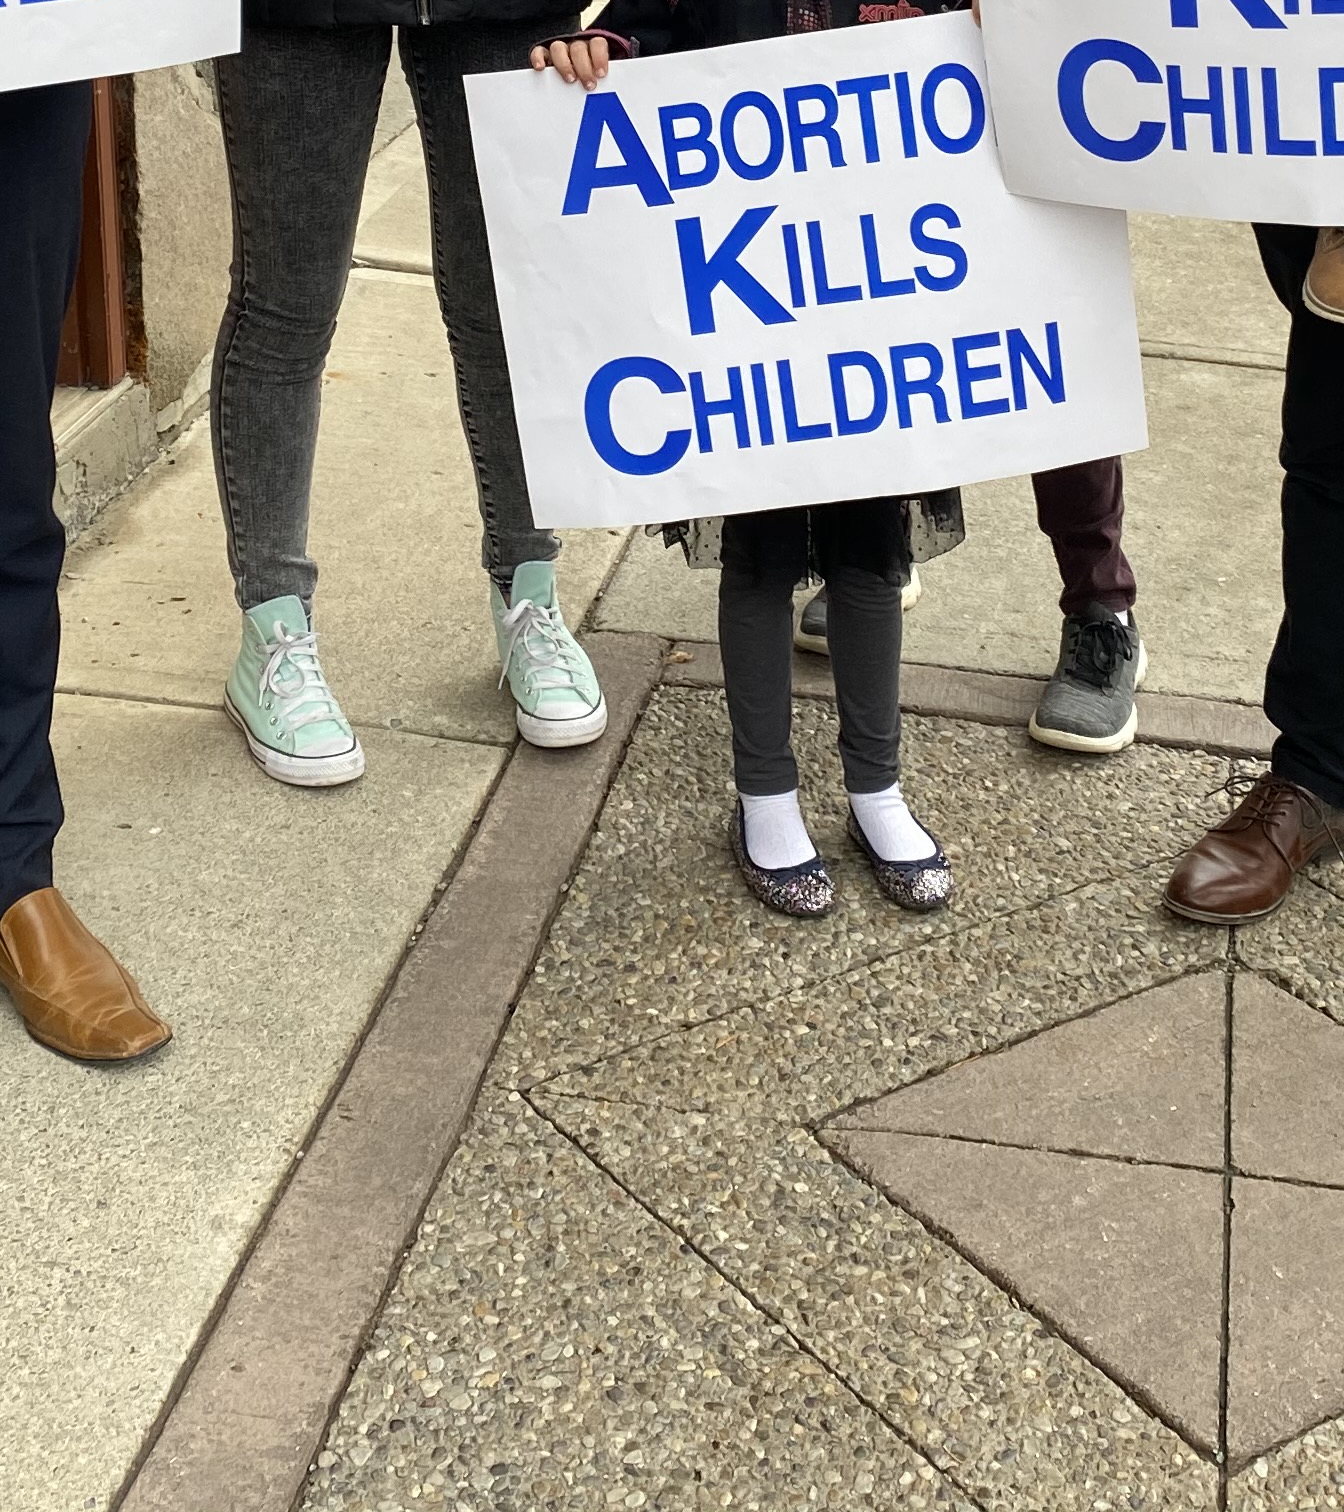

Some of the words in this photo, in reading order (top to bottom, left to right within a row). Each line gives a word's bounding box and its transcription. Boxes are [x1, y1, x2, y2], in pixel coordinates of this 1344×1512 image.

[561, 62, 989, 216] ABORTIO
[674, 202, 969, 337] KILLS
[583, 321, 1066, 477] CHILDREN
